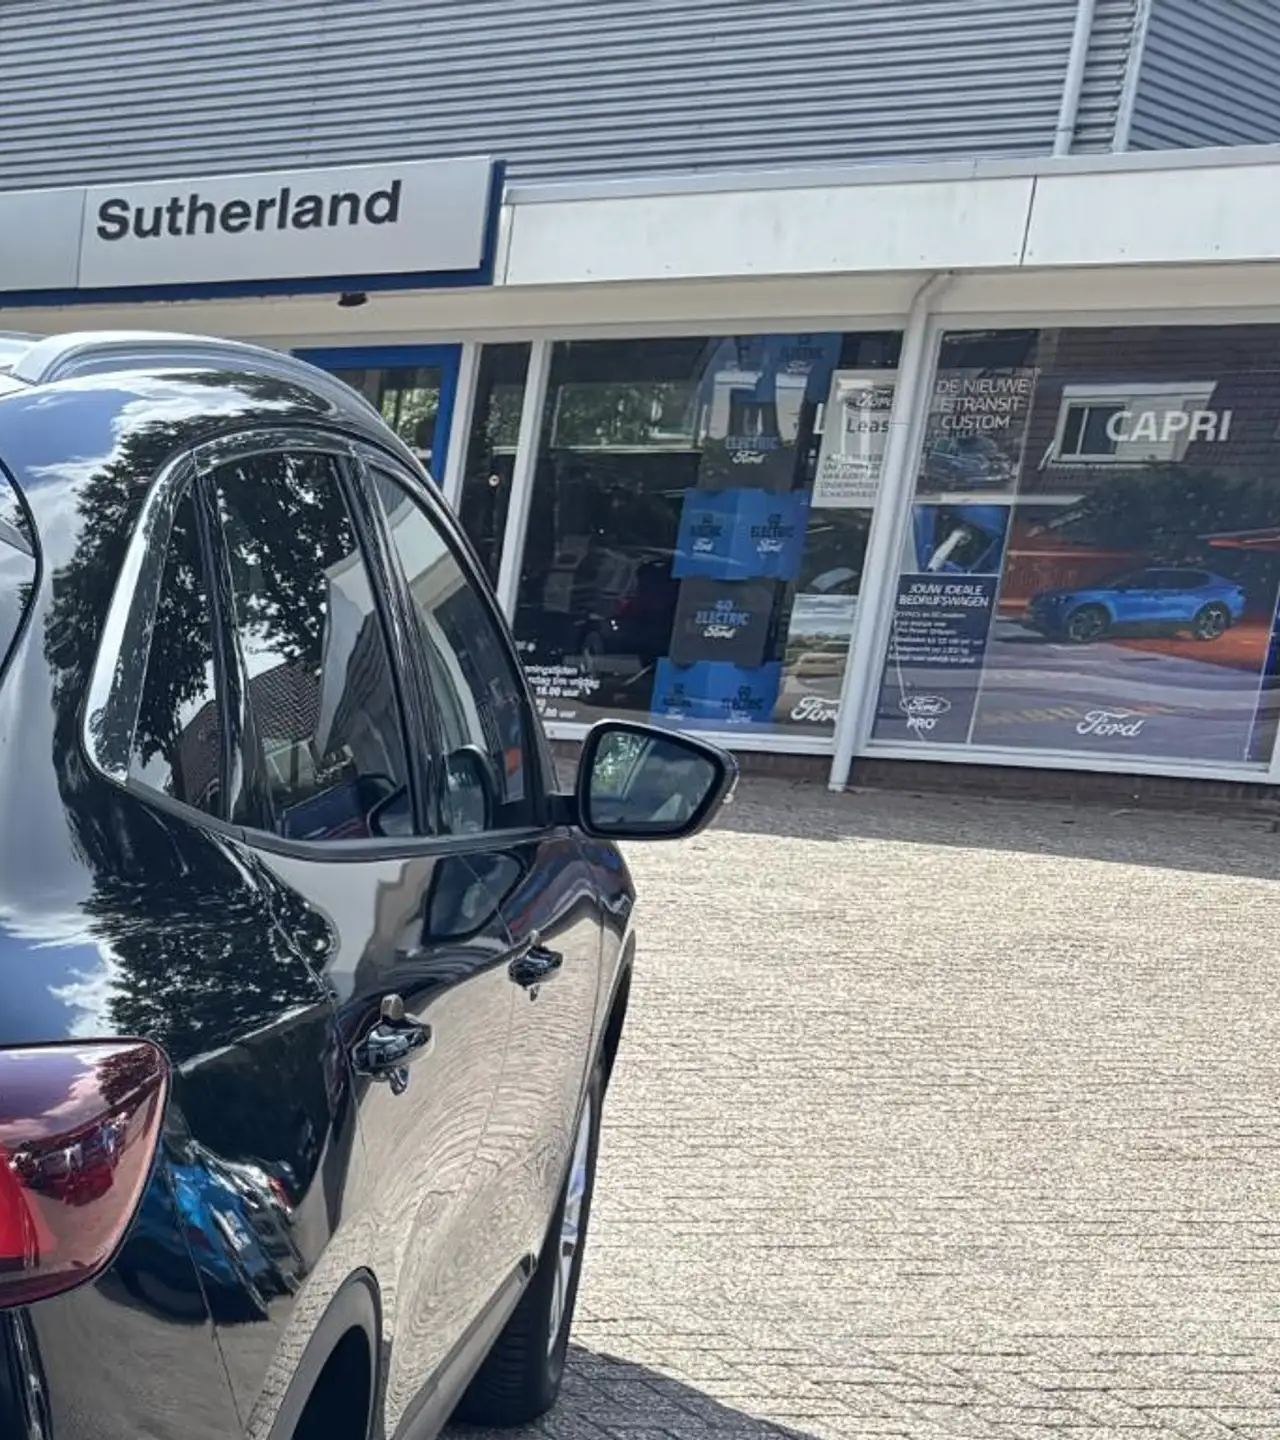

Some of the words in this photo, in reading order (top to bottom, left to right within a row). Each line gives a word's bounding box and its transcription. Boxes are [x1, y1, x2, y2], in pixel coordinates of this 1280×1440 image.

[96, 180, 402, 241] Sutherland
[937, 378, 960, 393] DE
[963, 378, 1029, 394] NIEUWE
[847, 418, 889, 433] Leas
[942, 415, 1010, 429] CUSTOM
[1106, 410, 1233, 442] CAPRI
[695, 611, 750, 626] ELECTRIC
[703, 625, 737, 638] Ford
[907, 717, 935, 730] PRO
[1076, 710, 1144, 737] Ford
